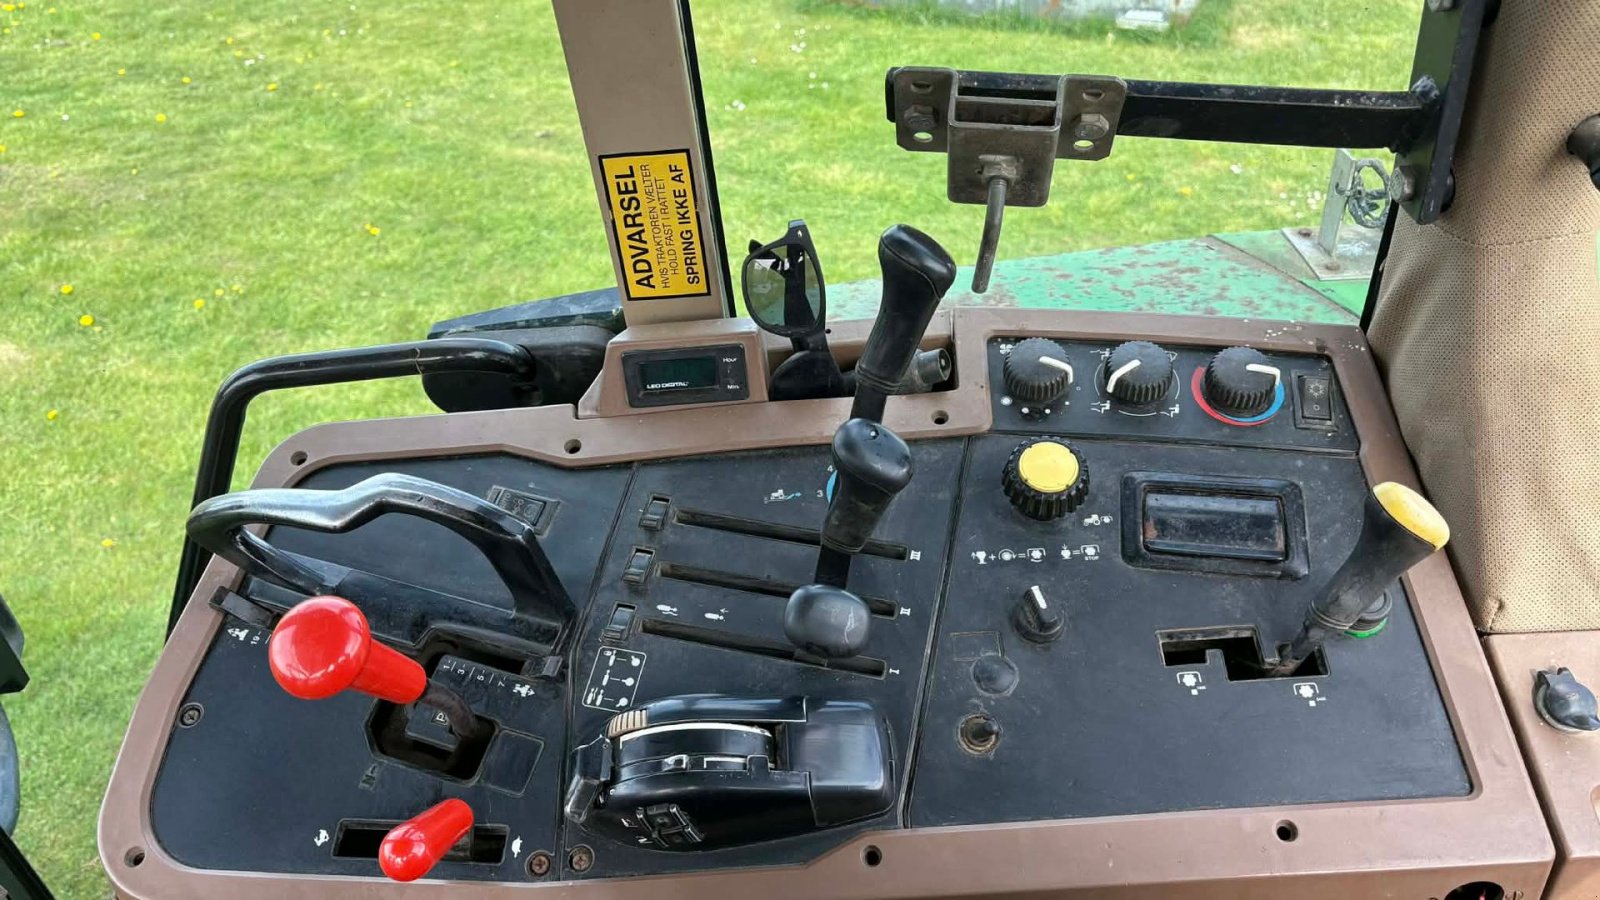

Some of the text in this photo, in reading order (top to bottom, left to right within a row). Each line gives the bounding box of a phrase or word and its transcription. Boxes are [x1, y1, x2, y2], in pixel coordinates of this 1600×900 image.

[654, 176, 669, 214] RATTET
[615, 165, 656, 289] ADVARSEL
[640, 164, 670, 289] HVIS TRAKTOREN VÆLTER
[663, 223, 673, 246] FAST
[669, 164, 700, 285] SPRING IKKE AF
[667, 248, 679, 275] HOLD
[817, 489, 824, 497] 3
[909, 550, 921, 561] III
[900, 606, 911, 616] II
[435, 712, 445, 722] P
